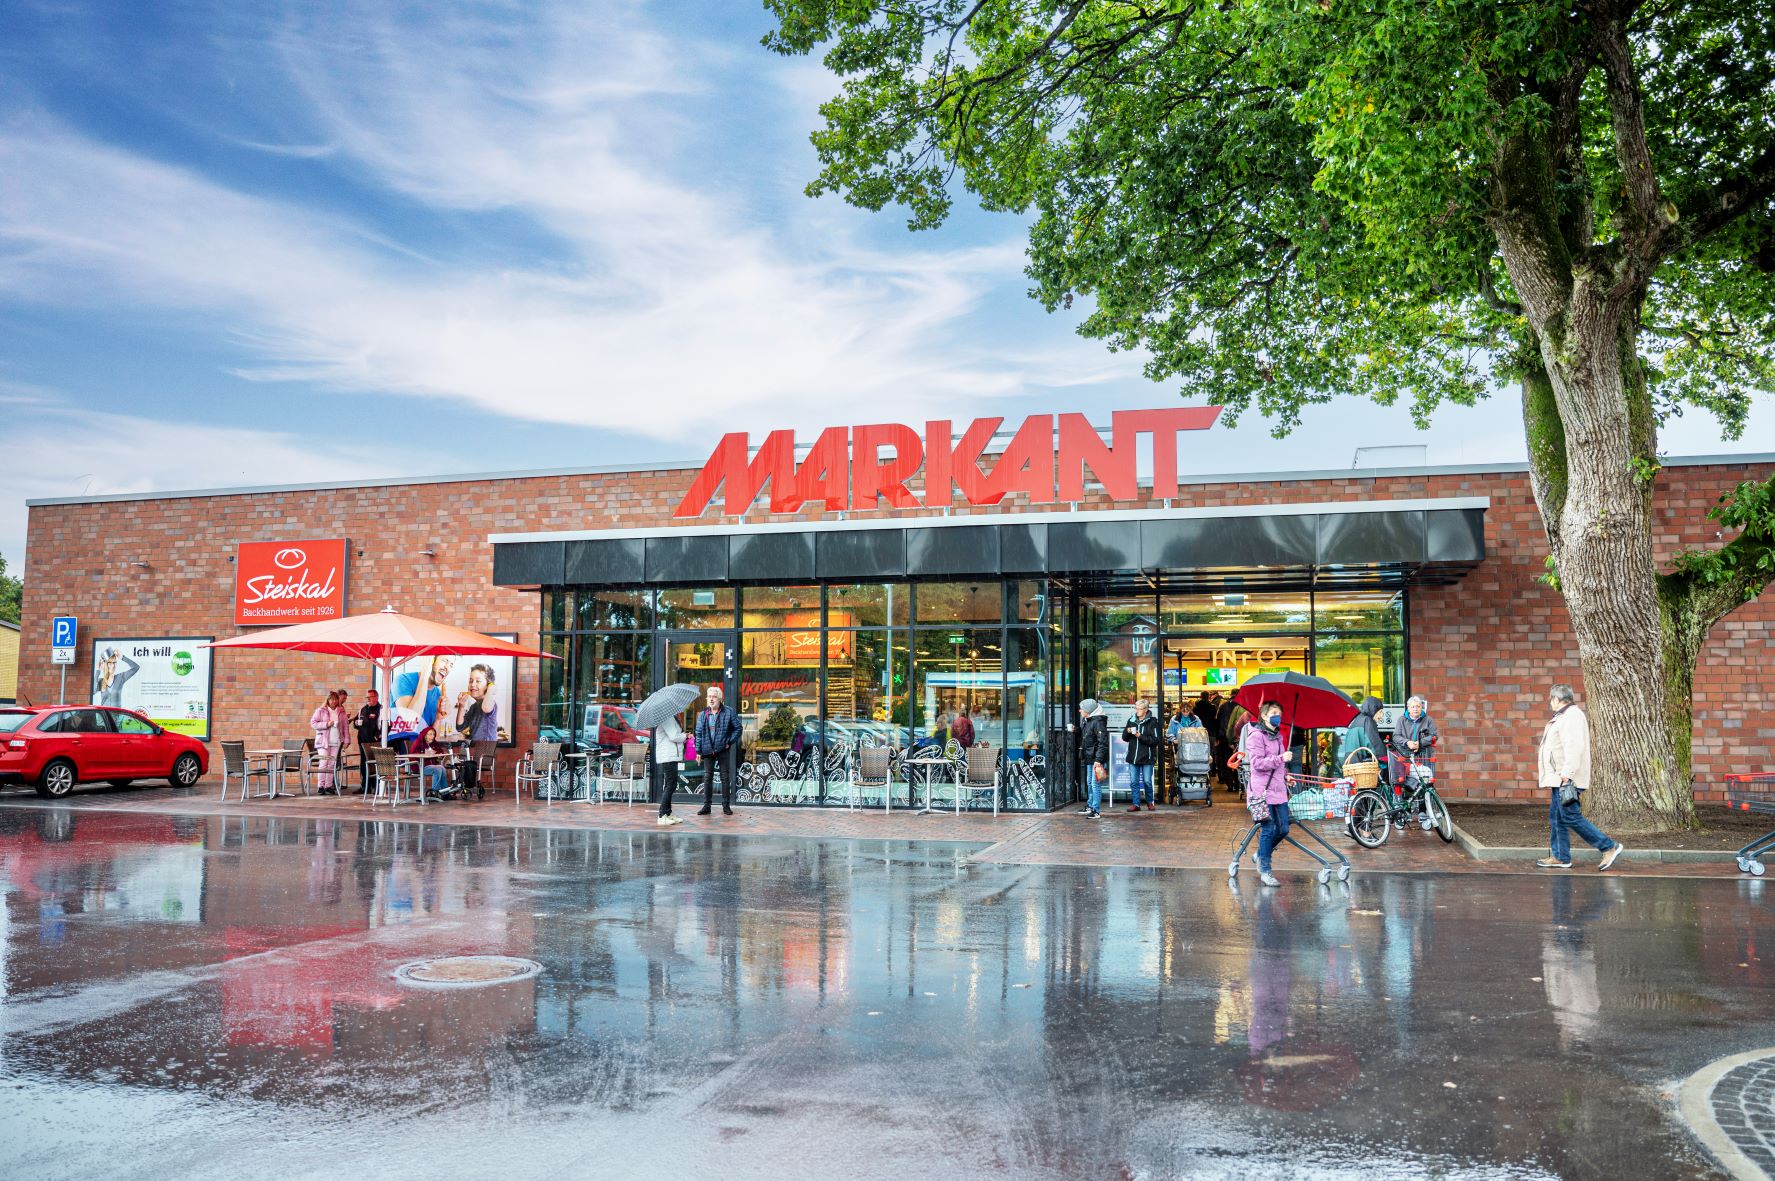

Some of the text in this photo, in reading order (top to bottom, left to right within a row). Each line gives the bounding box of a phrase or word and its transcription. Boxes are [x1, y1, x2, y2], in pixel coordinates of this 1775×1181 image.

[673, 406, 1224, 519] MARKANT
[243, 567, 336, 604] Steiskal
[243, 606, 335, 617] Backhandwerk seit 1926
[56, 621, 70, 644] P
[790, 631, 846, 648] Steisal
[59, 649, 67, 657] 2x
[133, 646, 171, 657] Ich will
[1212, 650, 1277, 667] INFO
